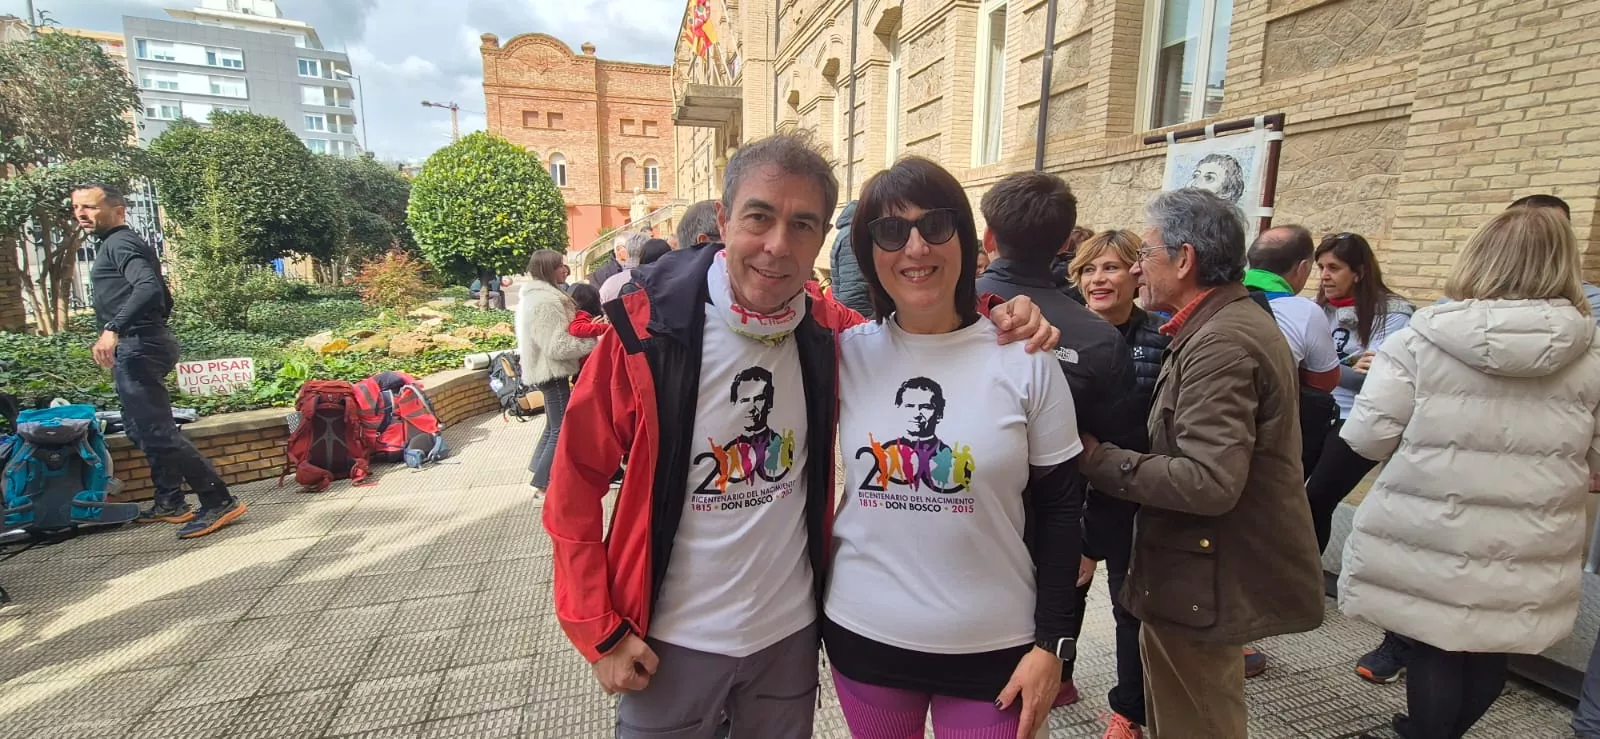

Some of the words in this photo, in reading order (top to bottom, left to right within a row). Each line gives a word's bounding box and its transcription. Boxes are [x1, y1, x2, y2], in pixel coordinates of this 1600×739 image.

[179, 363, 204, 375] NO
[207, 359, 250, 372] PISAR
[184, 373, 230, 386] JUGAR
[234, 371, 252, 382] EN
[691, 492, 745, 504] BICENTENARIO
[746, 490, 759, 498] DEL
[691, 503, 712, 512] 1815
[721, 502, 742, 511] DON
[744, 495, 773, 508] BOSCO
[858, 491, 909, 502] BICENTENARIO
[910, 495, 923, 504] DEL
[925, 496, 975, 505] NACIMIENTO
[859, 499, 878, 508] 1815
[885, 501, 907, 511] DON
[909, 503, 942, 513] BOSCO
[951, 505, 974, 513] 2015
